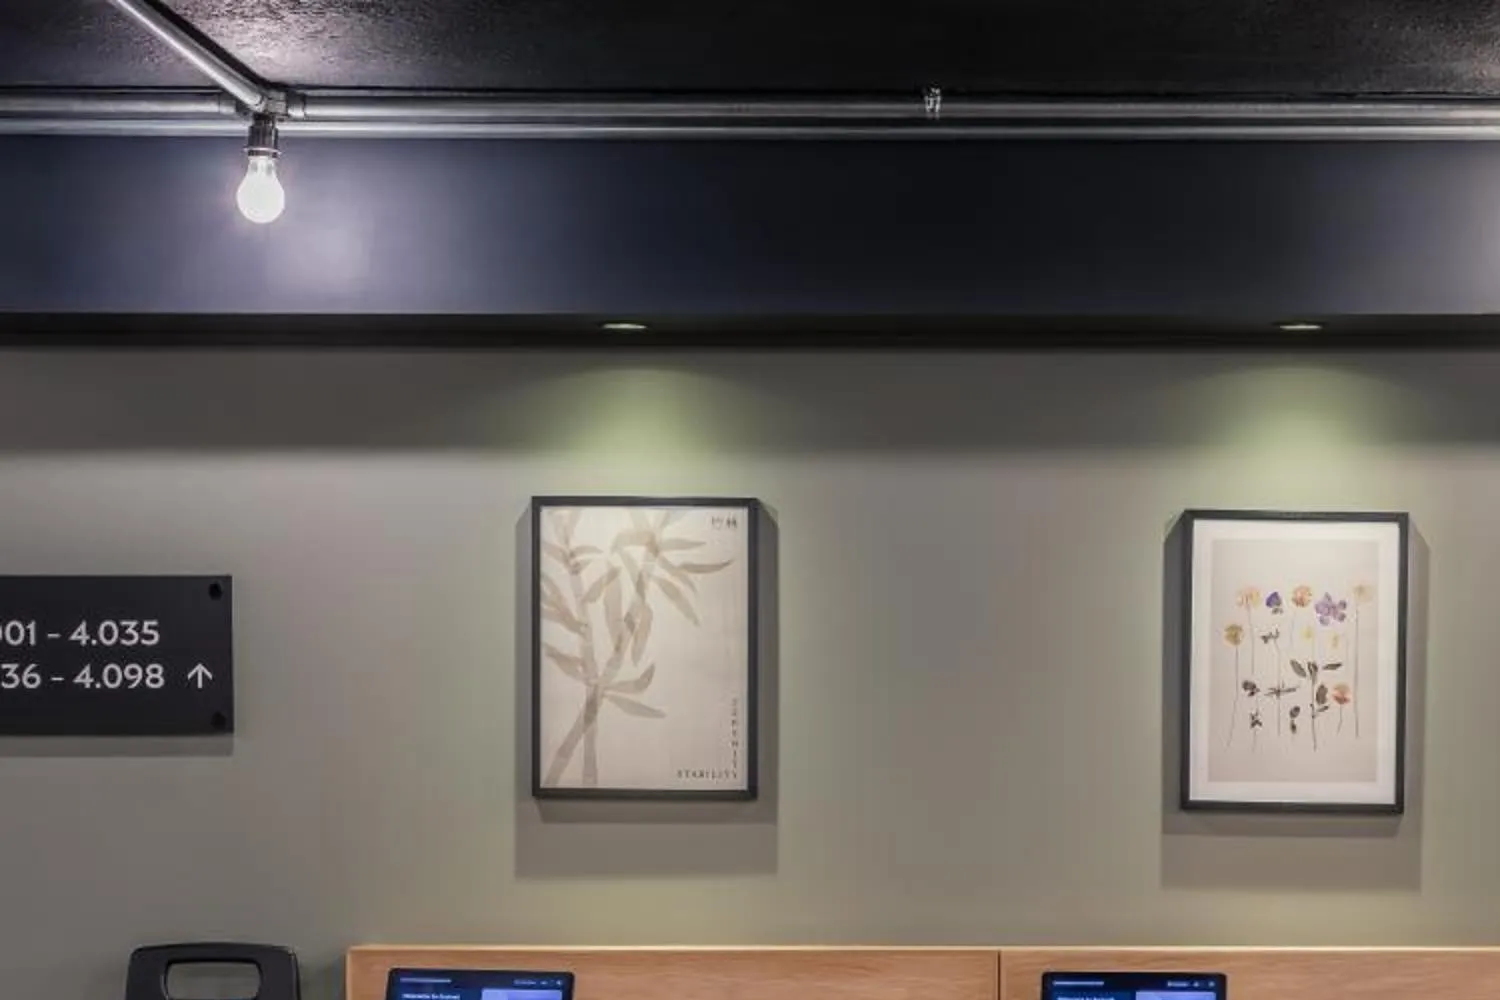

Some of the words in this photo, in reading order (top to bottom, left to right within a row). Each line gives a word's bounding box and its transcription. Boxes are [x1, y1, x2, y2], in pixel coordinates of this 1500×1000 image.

[0, 620, 37, 646] 01
[68, 620, 160, 647] 4.035
[72, 663, 165, 690] 4.098
